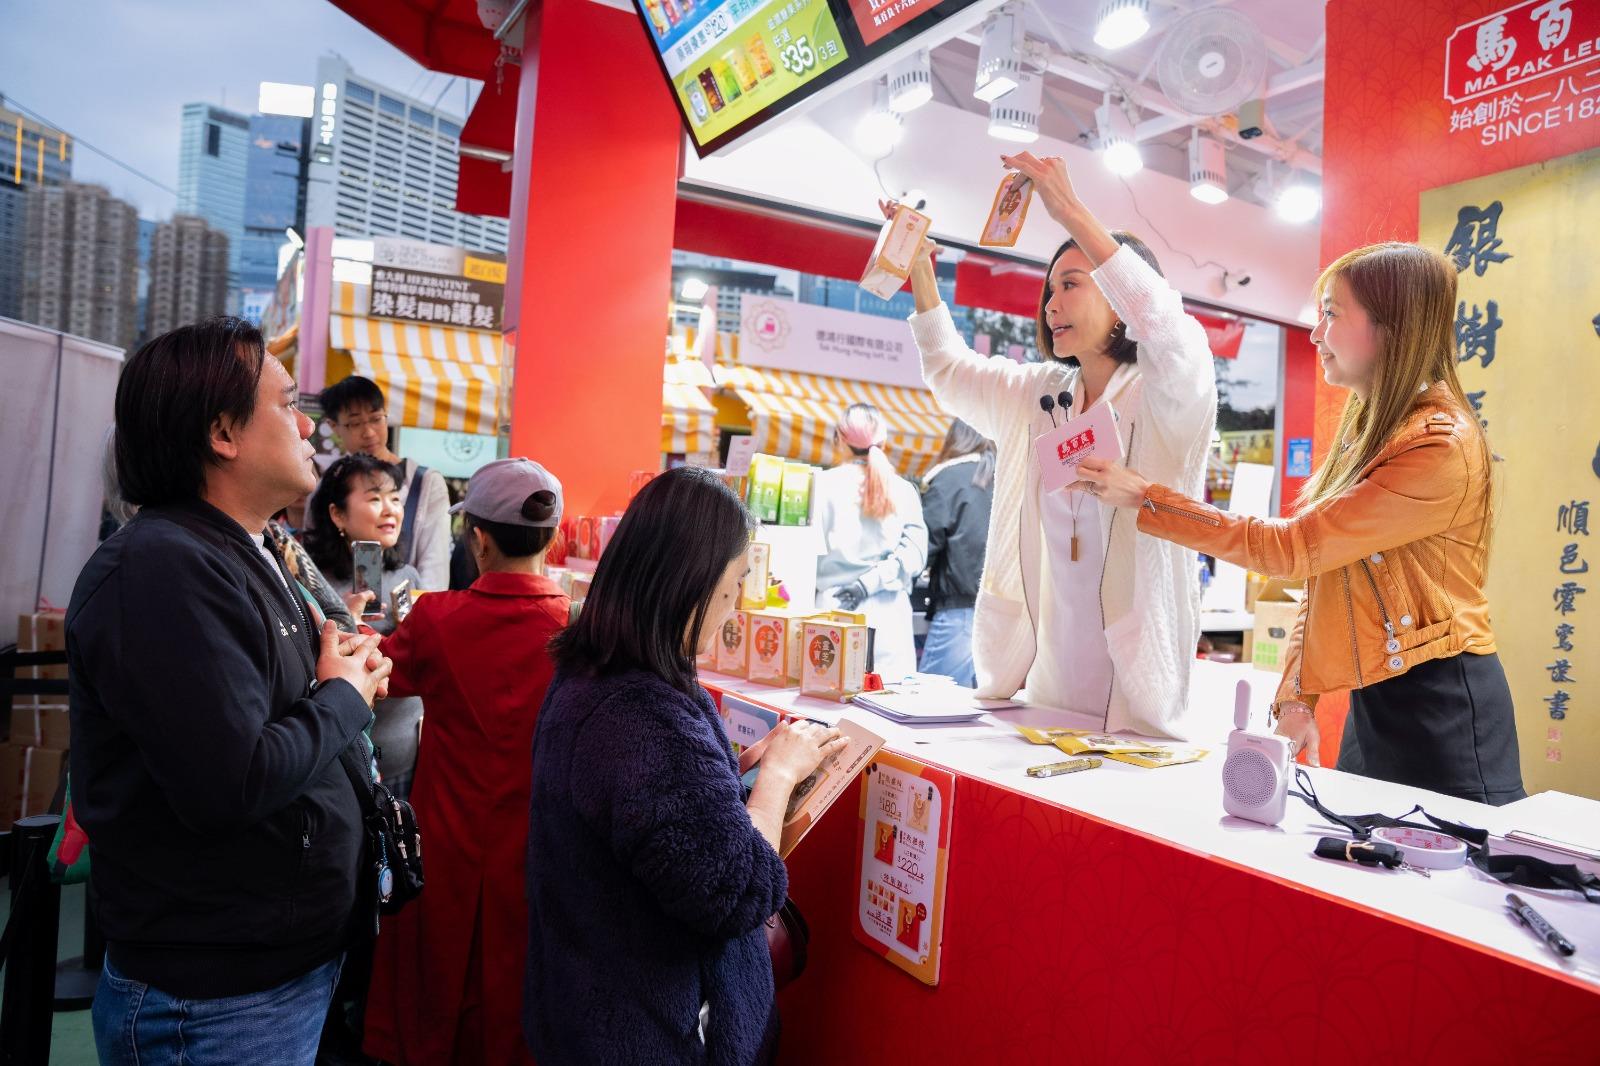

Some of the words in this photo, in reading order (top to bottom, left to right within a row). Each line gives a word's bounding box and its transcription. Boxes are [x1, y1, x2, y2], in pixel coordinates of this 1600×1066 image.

[1464, 73, 1497, 95] MA
[1505, 53, 1553, 82] PAK
[372, 291, 495, 328] 染髮同時護髮
